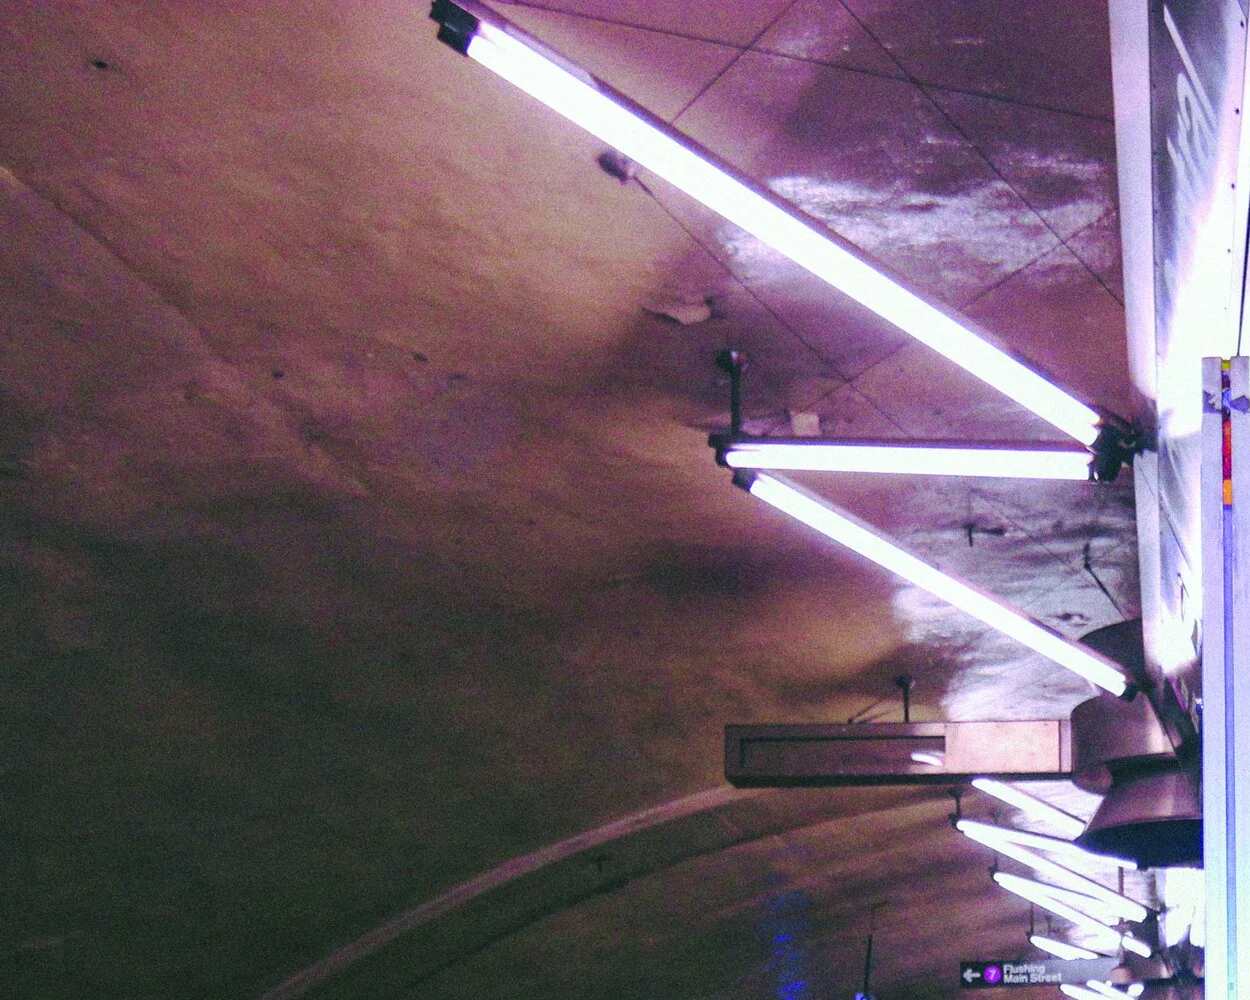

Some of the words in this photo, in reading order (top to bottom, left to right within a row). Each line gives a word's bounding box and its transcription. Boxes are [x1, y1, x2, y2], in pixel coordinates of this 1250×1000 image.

[1003, 964, 1046, 975] Flushing
[1003, 974, 1028, 984] Main
[1030, 973, 1062, 983] Street
